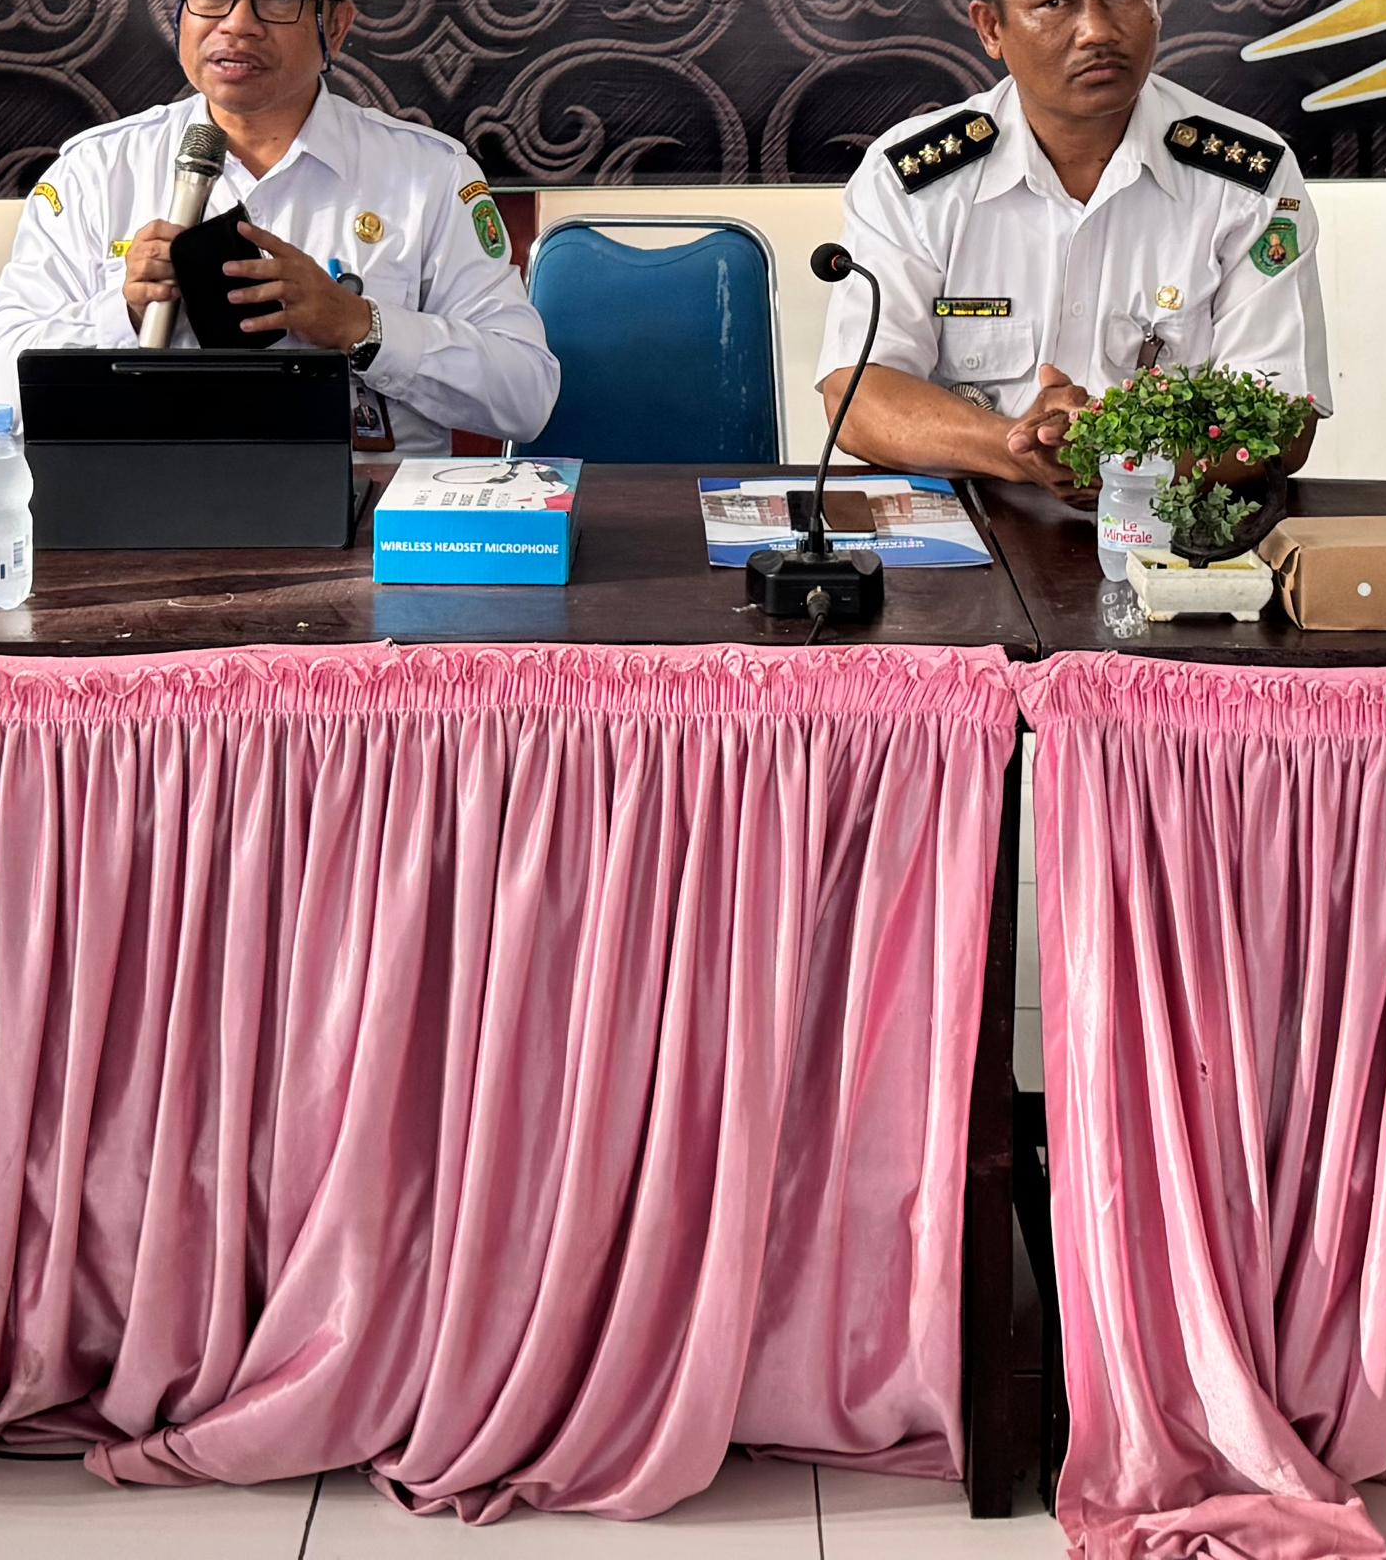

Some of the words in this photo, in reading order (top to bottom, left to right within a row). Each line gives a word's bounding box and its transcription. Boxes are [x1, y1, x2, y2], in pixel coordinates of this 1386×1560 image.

[1122, 518, 1138, 533] Le
[1103, 528, 1153, 544] Minerale
[380, 541, 433, 553] WIRELESS
[434, 542, 481, 553] HEADSET
[485, 543, 560, 555] MICROPHONE
